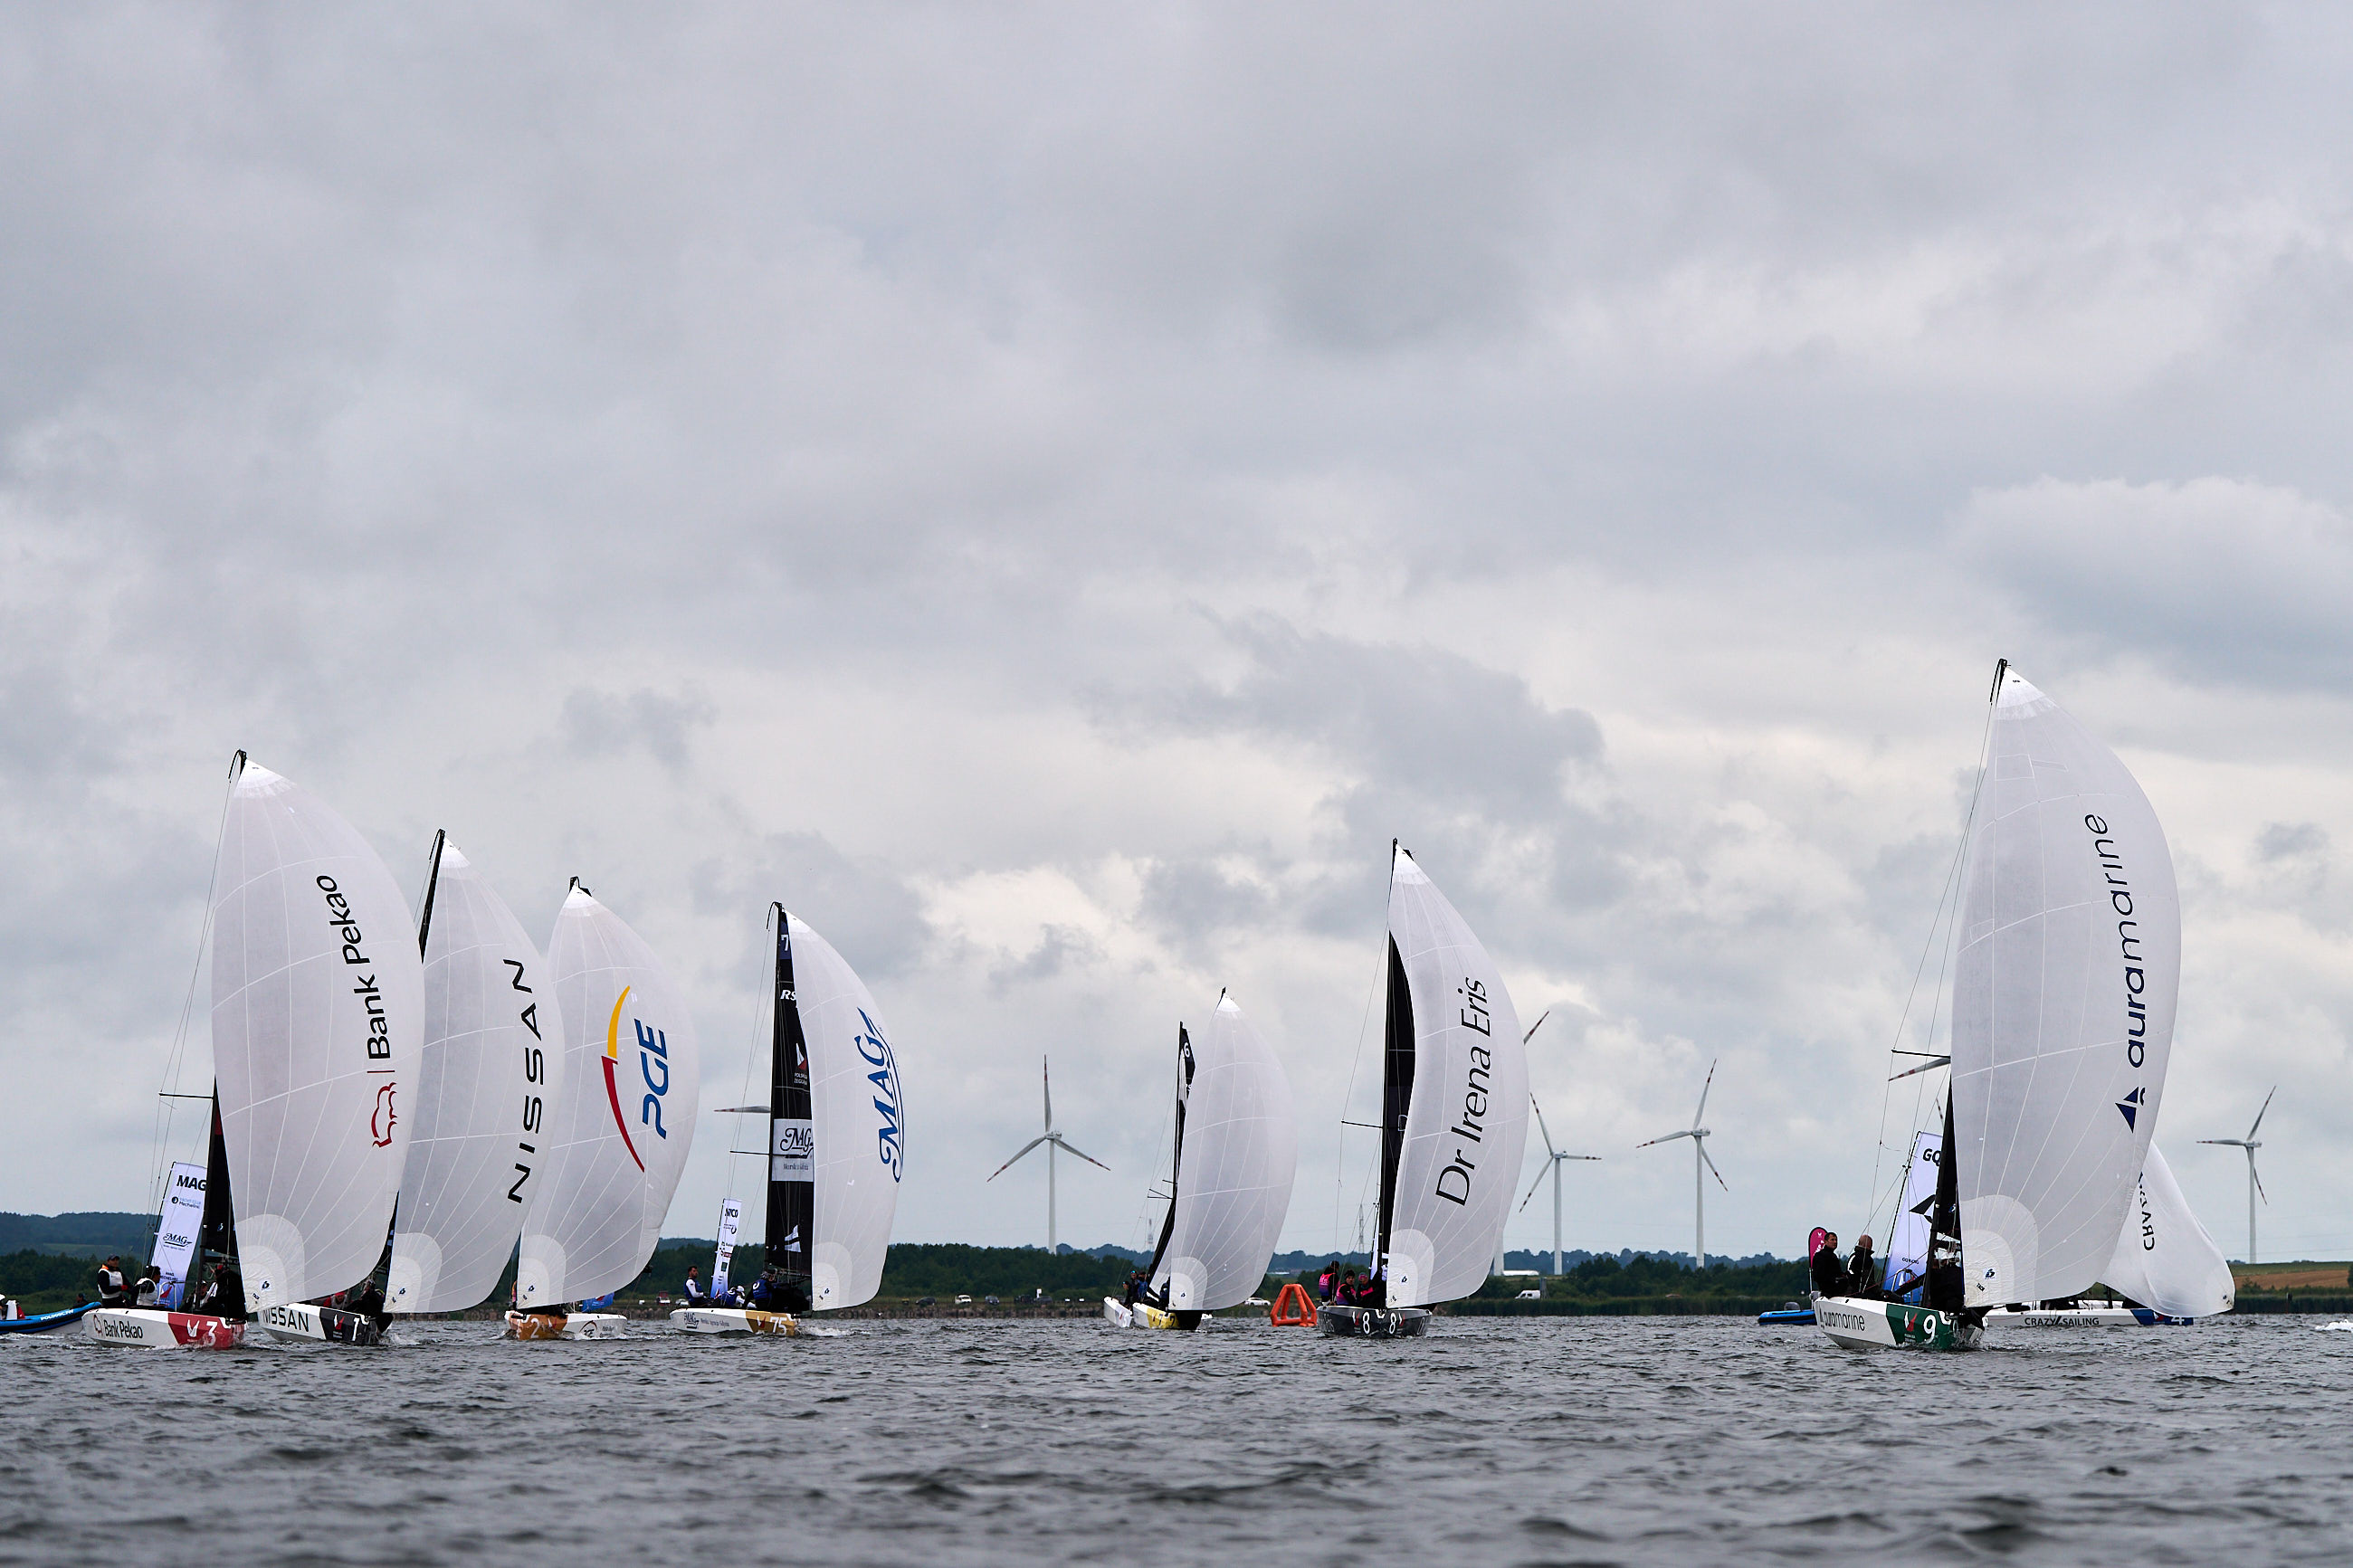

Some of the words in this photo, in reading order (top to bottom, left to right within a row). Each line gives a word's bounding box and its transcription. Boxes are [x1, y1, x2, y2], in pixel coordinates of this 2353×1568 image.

[316, 874, 371, 965] Pekao
[2084, 813, 2146, 1068] auramarine
[353, 974, 391, 1060] Bank
[1458, 976, 1491, 1038] Eris
[1183, 1041, 1191, 1058] 6
[503, 959, 544, 1204] NISSAN
[634, 1018, 669, 1140] PGE
[853, 1013, 904, 1182] MAG
[1451, 1045, 1491, 1144] Irena
[176, 1174, 207, 1192] MAG
[1435, 1148, 1475, 1207] Dr
[103, 1319, 119, 1339] Bank
[119, 1320, 143, 1339] Pekao
[263, 1307, 310, 1332] NISSAN
[352, 1317, 359, 1342] 1
[529, 1317, 540, 1339] 2
[770, 1316, 787, 1335] 75
[1362, 1312, 1370, 1335] 8
[1389, 1312, 1396, 1335] 8
[1824, 1311, 1865, 1331] auramarine
[1923, 1314, 1937, 1345] 9
[2024, 1317, 2055, 1326] CRAZY
[2062, 1317, 2100, 1326] SAILING
[205, 1321, 218, 1346] 3
